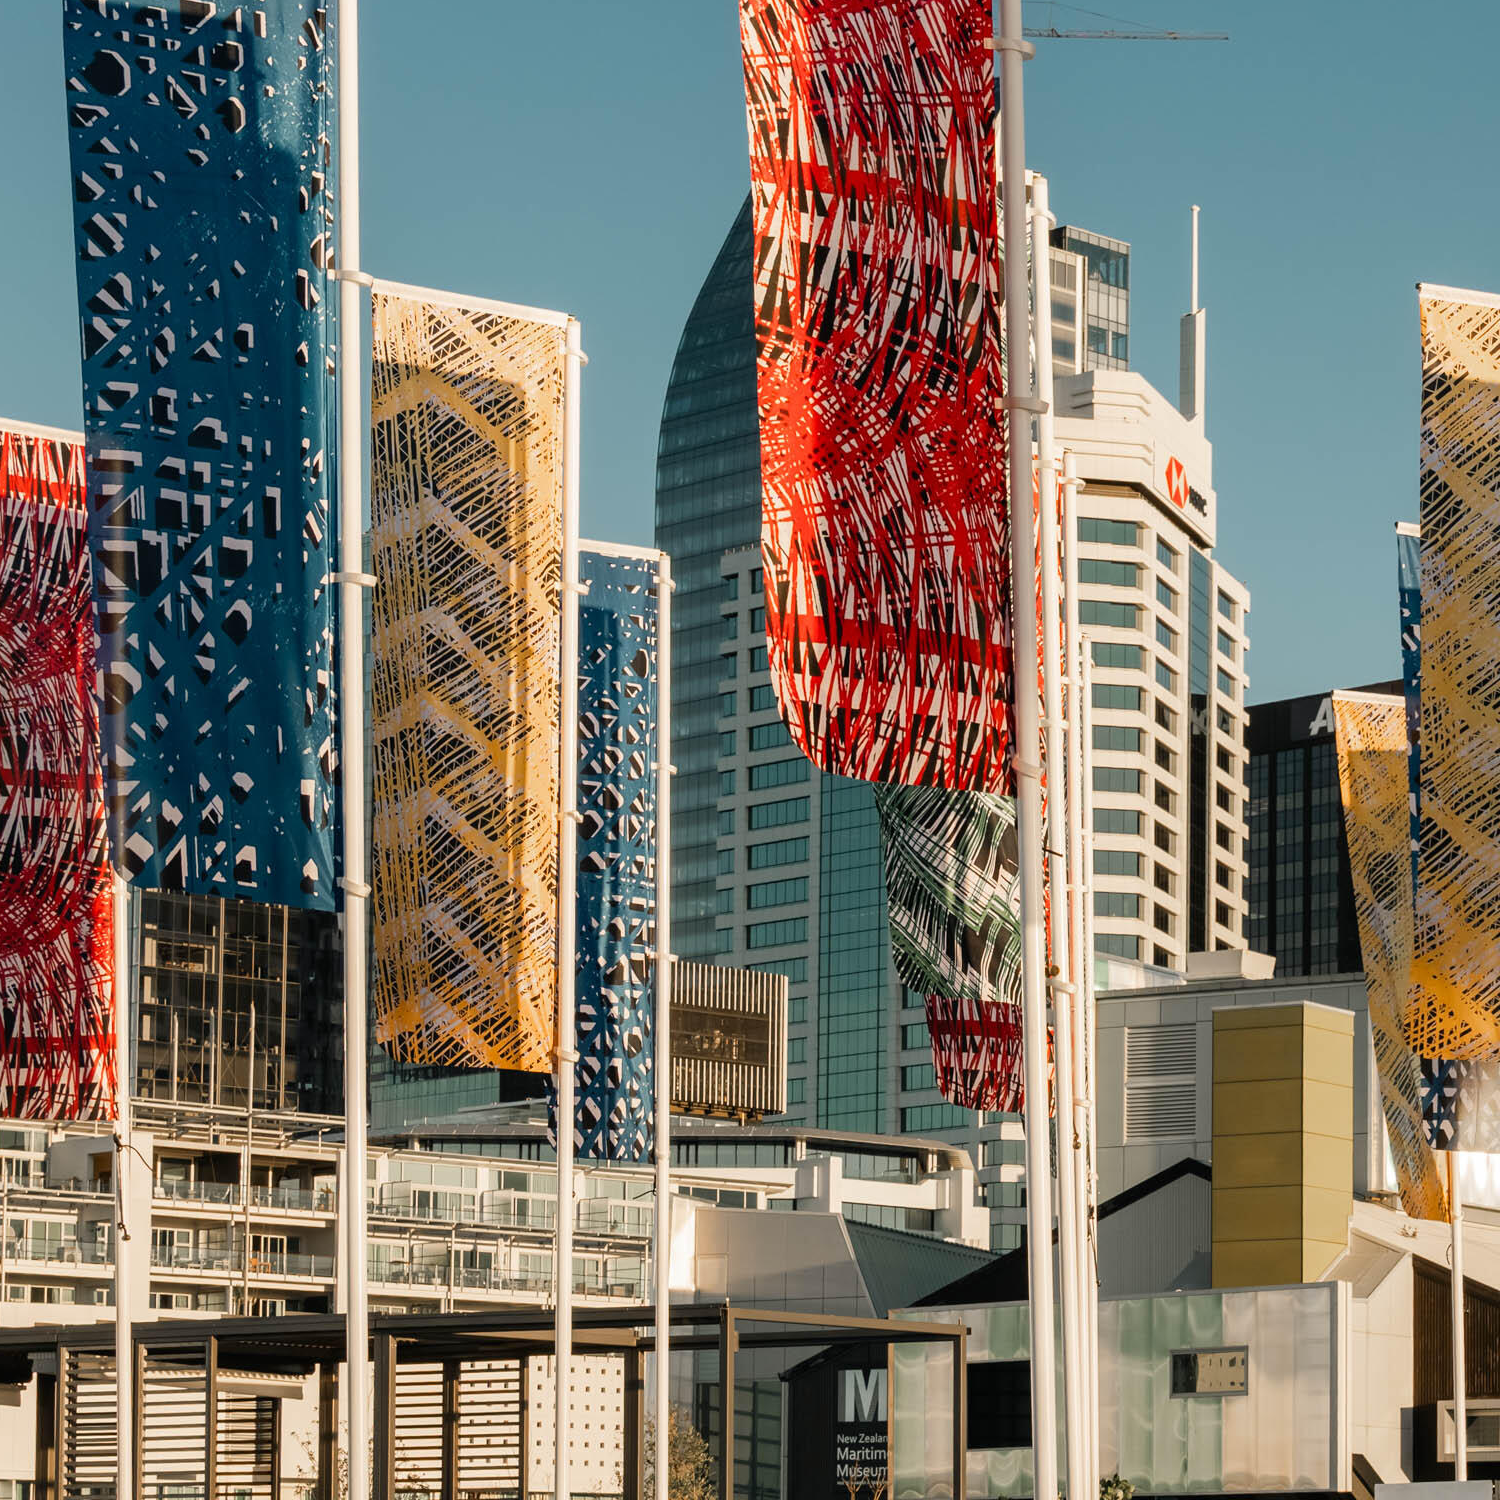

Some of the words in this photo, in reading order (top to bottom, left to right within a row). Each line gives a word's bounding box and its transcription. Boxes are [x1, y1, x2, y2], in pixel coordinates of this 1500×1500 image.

[837, 1368, 888, 1422] M
[836, 1434, 857, 1444] New
[858, 1433, 888, 1444] Zealan
[836, 1447, 888, 1461] Maritim
